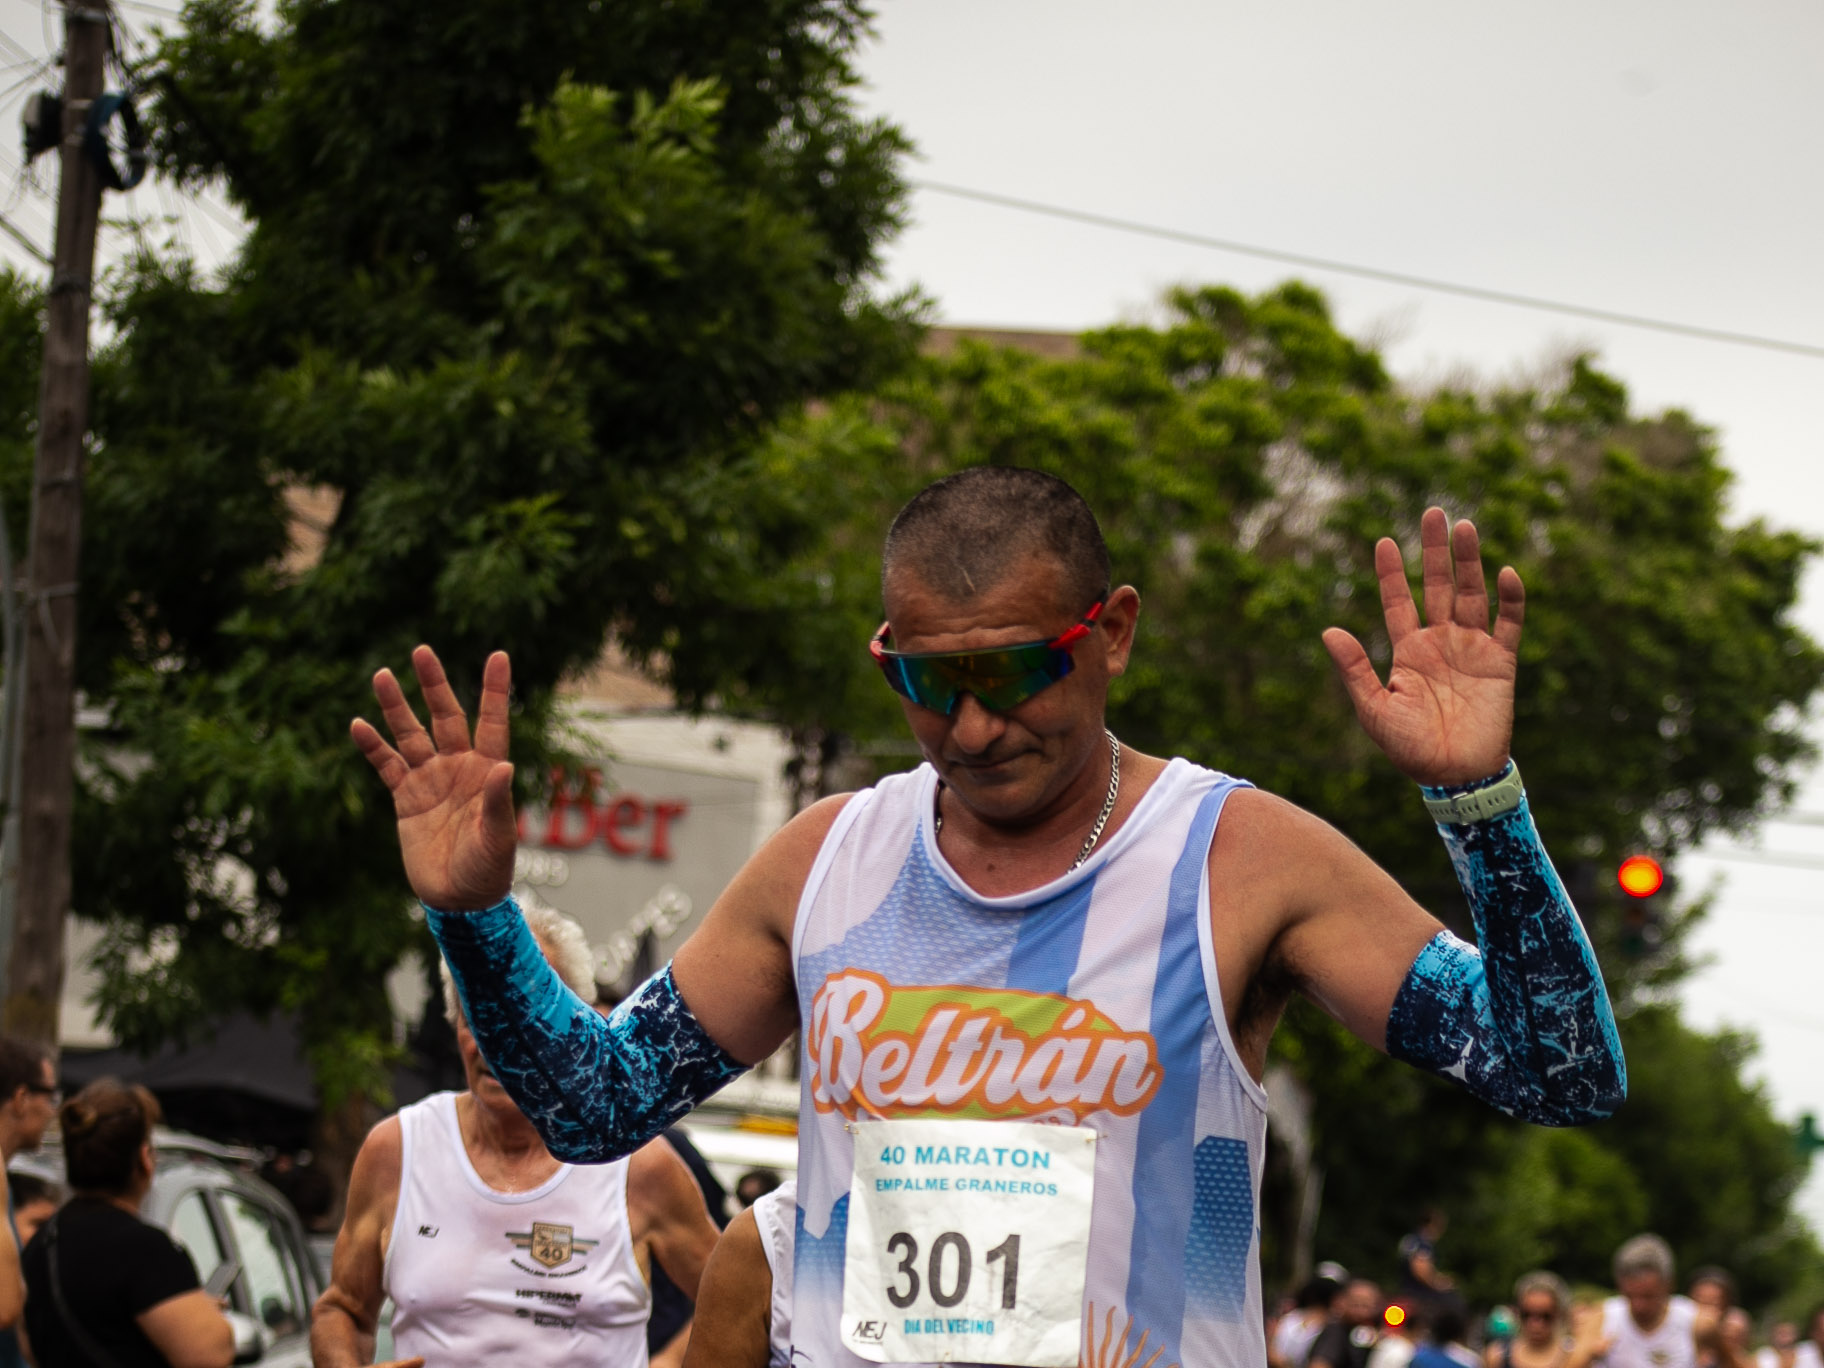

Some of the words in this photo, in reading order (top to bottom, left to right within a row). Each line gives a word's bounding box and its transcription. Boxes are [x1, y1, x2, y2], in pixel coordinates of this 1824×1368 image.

[811, 972, 1160, 1112] Beltrán
[880, 1145, 905, 1165] 40
[915, 1146, 1050, 1169] MARATON
[875, 1178, 949, 1192] EMPALME
[955, 1178, 1058, 1196] GRANEROS
[886, 1231, 1021, 1310] 301
[904, 1319, 921, 1334] DIA
[925, 1319, 944, 1335] DEL
[947, 1319, 995, 1336] VECINO
